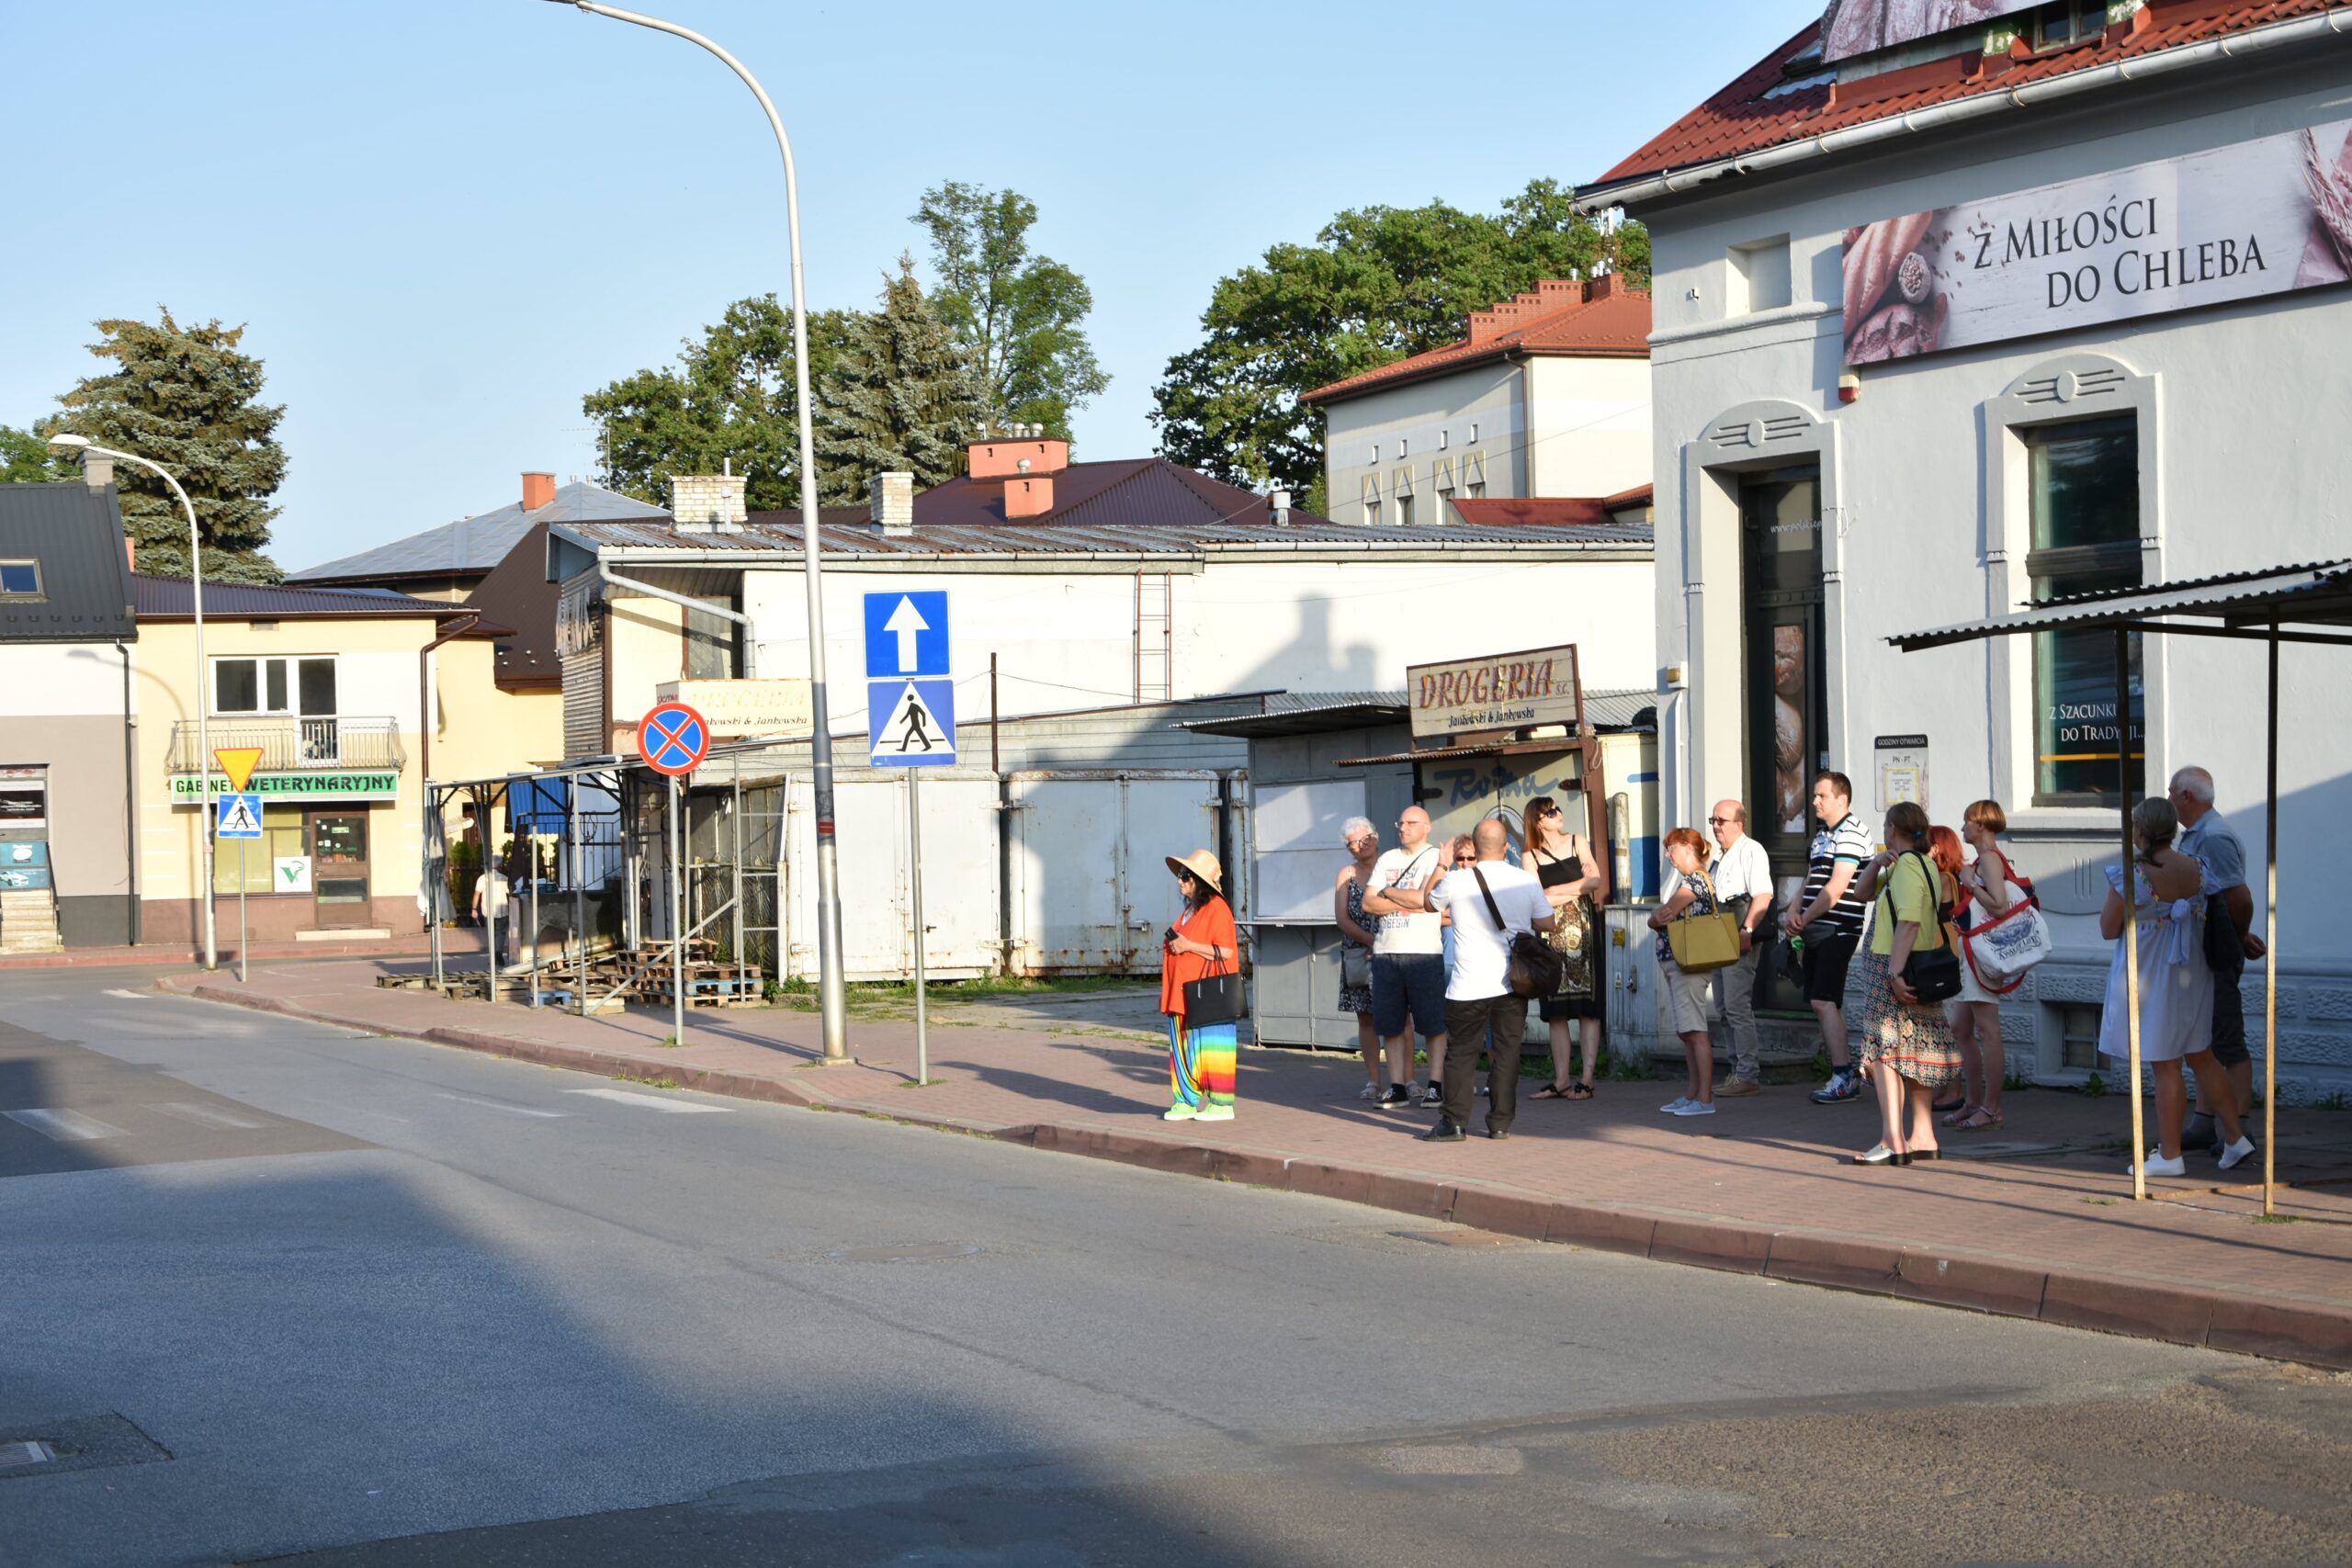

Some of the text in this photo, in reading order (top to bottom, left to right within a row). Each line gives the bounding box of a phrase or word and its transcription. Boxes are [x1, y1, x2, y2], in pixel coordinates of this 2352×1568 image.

[1973, 193, 2157, 269] Z MIŁOŚCI
[2046, 234, 2267, 310] DO CHLEBA
[1419, 658, 1553, 708] DROGERIA
[705, 716, 741, 726] nkowski
[2061, 727, 2079, 742] DO
[176, 773, 395, 793] GABNET WETERYNARYJNY
